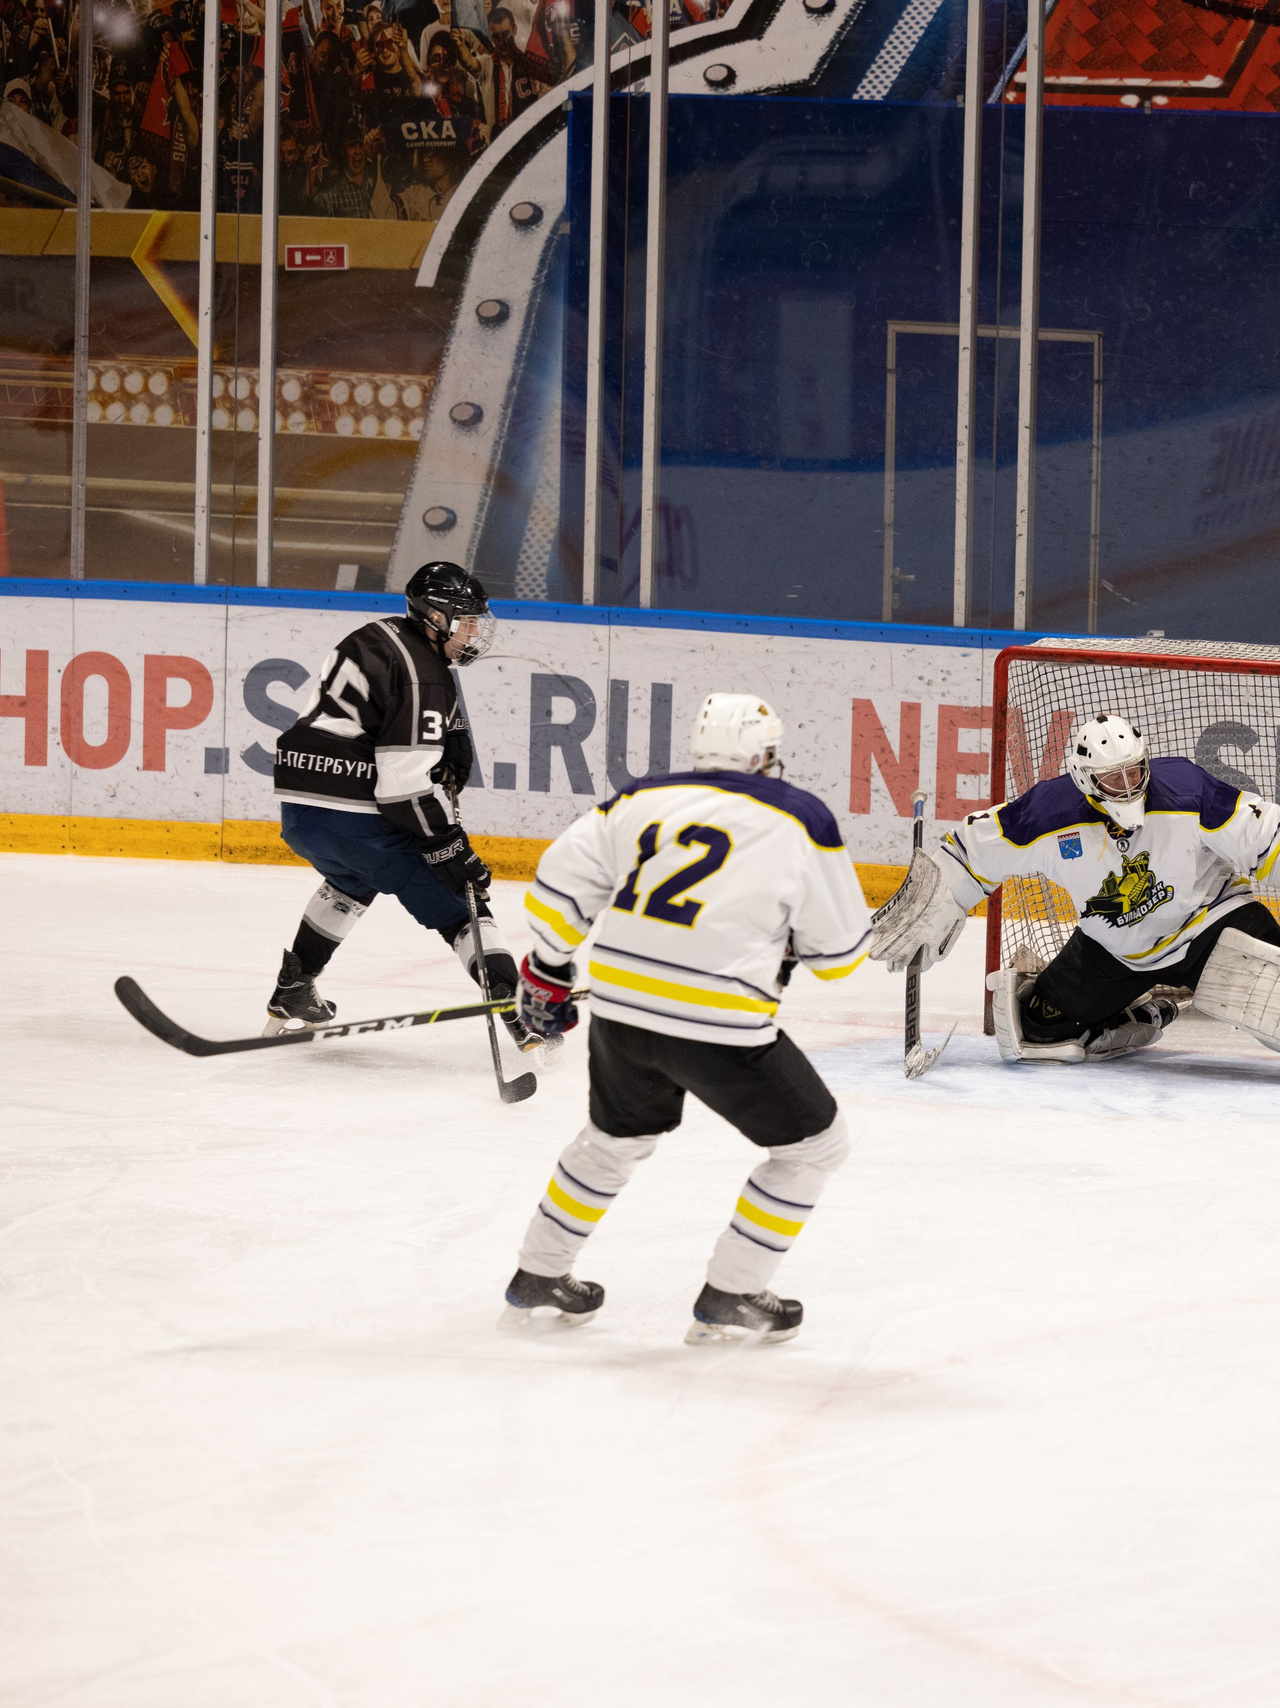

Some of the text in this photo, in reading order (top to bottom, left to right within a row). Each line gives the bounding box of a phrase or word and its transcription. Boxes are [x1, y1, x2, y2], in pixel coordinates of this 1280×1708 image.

[401, 120, 457, 140] СКА
[274, 748, 376, 780] Т-ПЕТЕРБУРГ
[611, 821, 734, 929] 12
[312, 1016, 415, 1042] CCM
